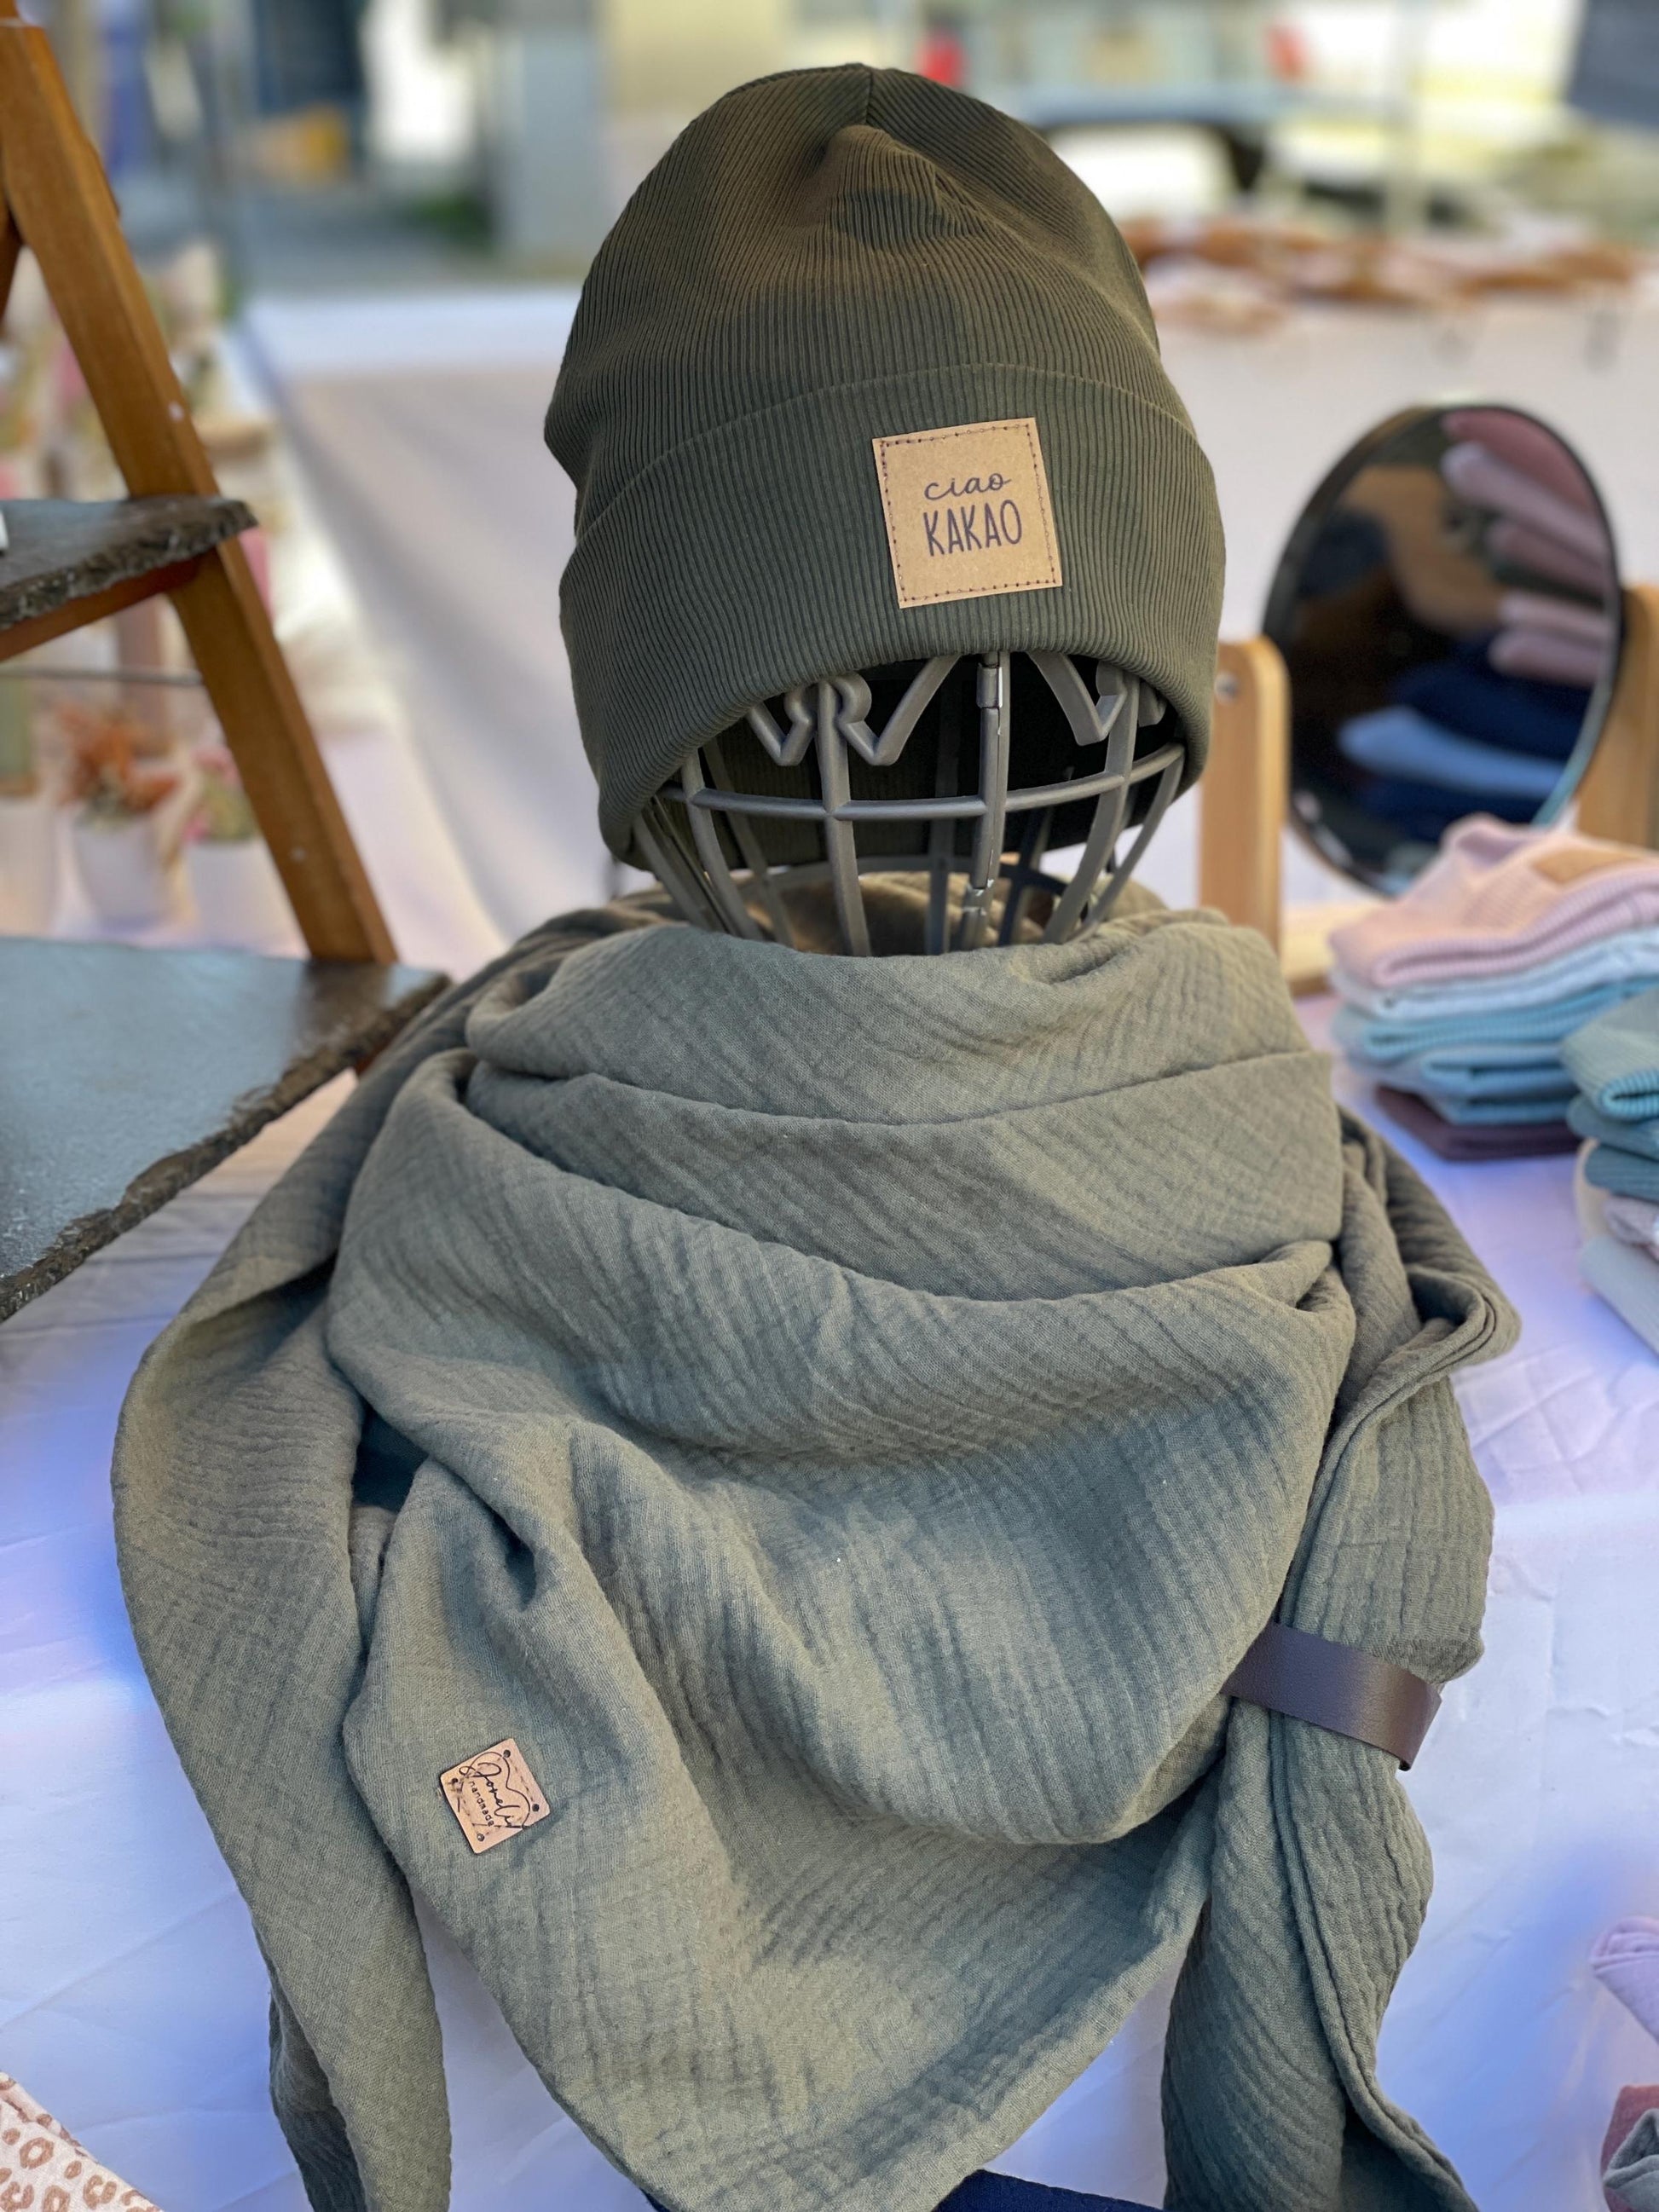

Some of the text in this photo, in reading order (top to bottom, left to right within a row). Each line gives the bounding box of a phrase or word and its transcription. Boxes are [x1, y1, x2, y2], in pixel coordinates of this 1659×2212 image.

[923, 473, 1012, 501] ciao
[922, 500, 1022, 557] KAKAO
[469, 1780, 495, 1827] handmade
